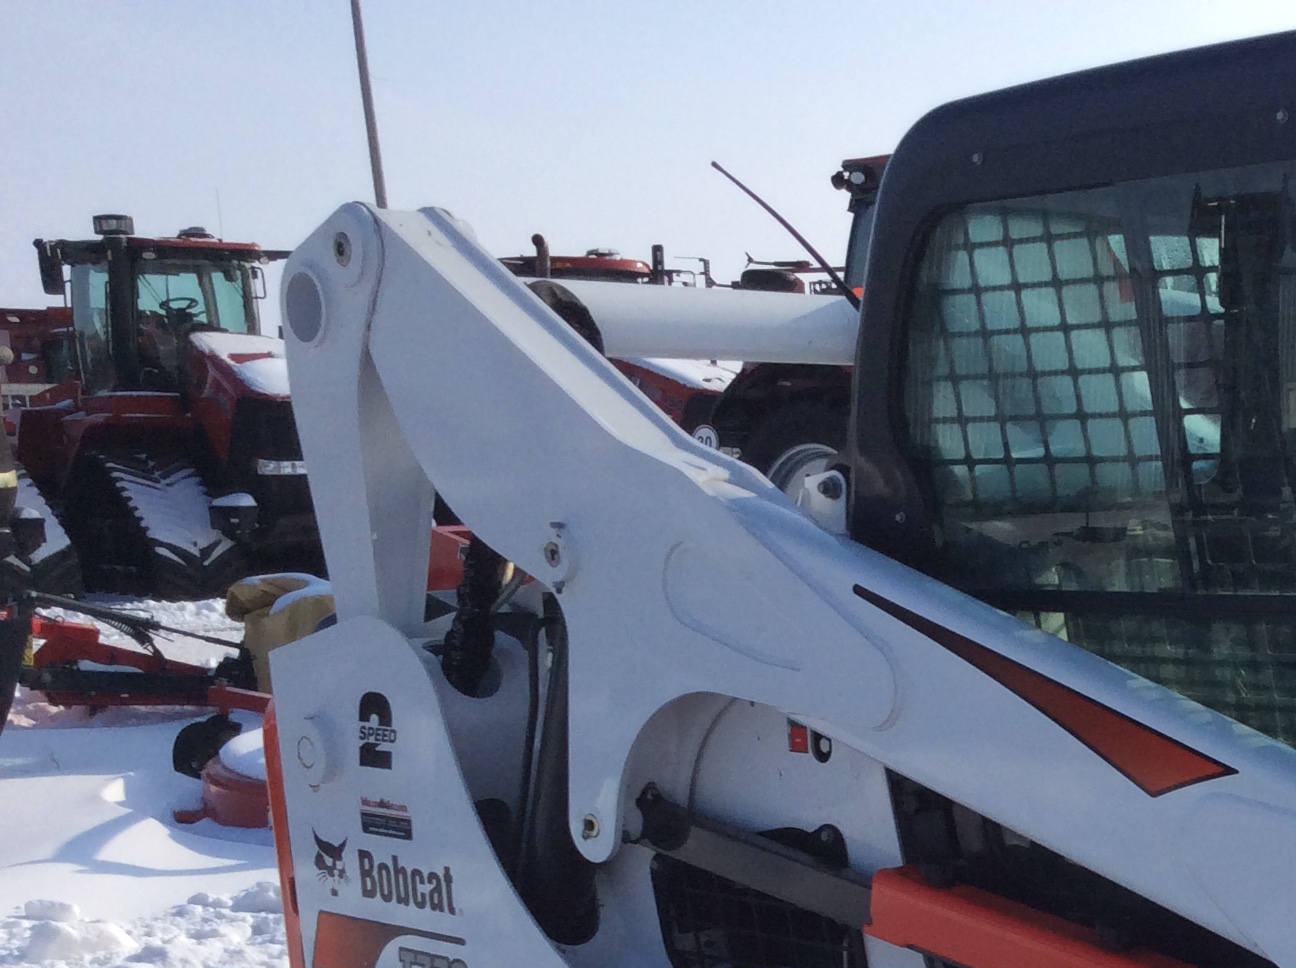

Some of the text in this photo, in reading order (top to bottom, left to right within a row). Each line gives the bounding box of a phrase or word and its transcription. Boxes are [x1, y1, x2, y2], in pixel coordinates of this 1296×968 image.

[359, 691, 392, 770] 2
[359, 725, 397, 744] SPEED
[357, 848, 456, 915] Bobcat
